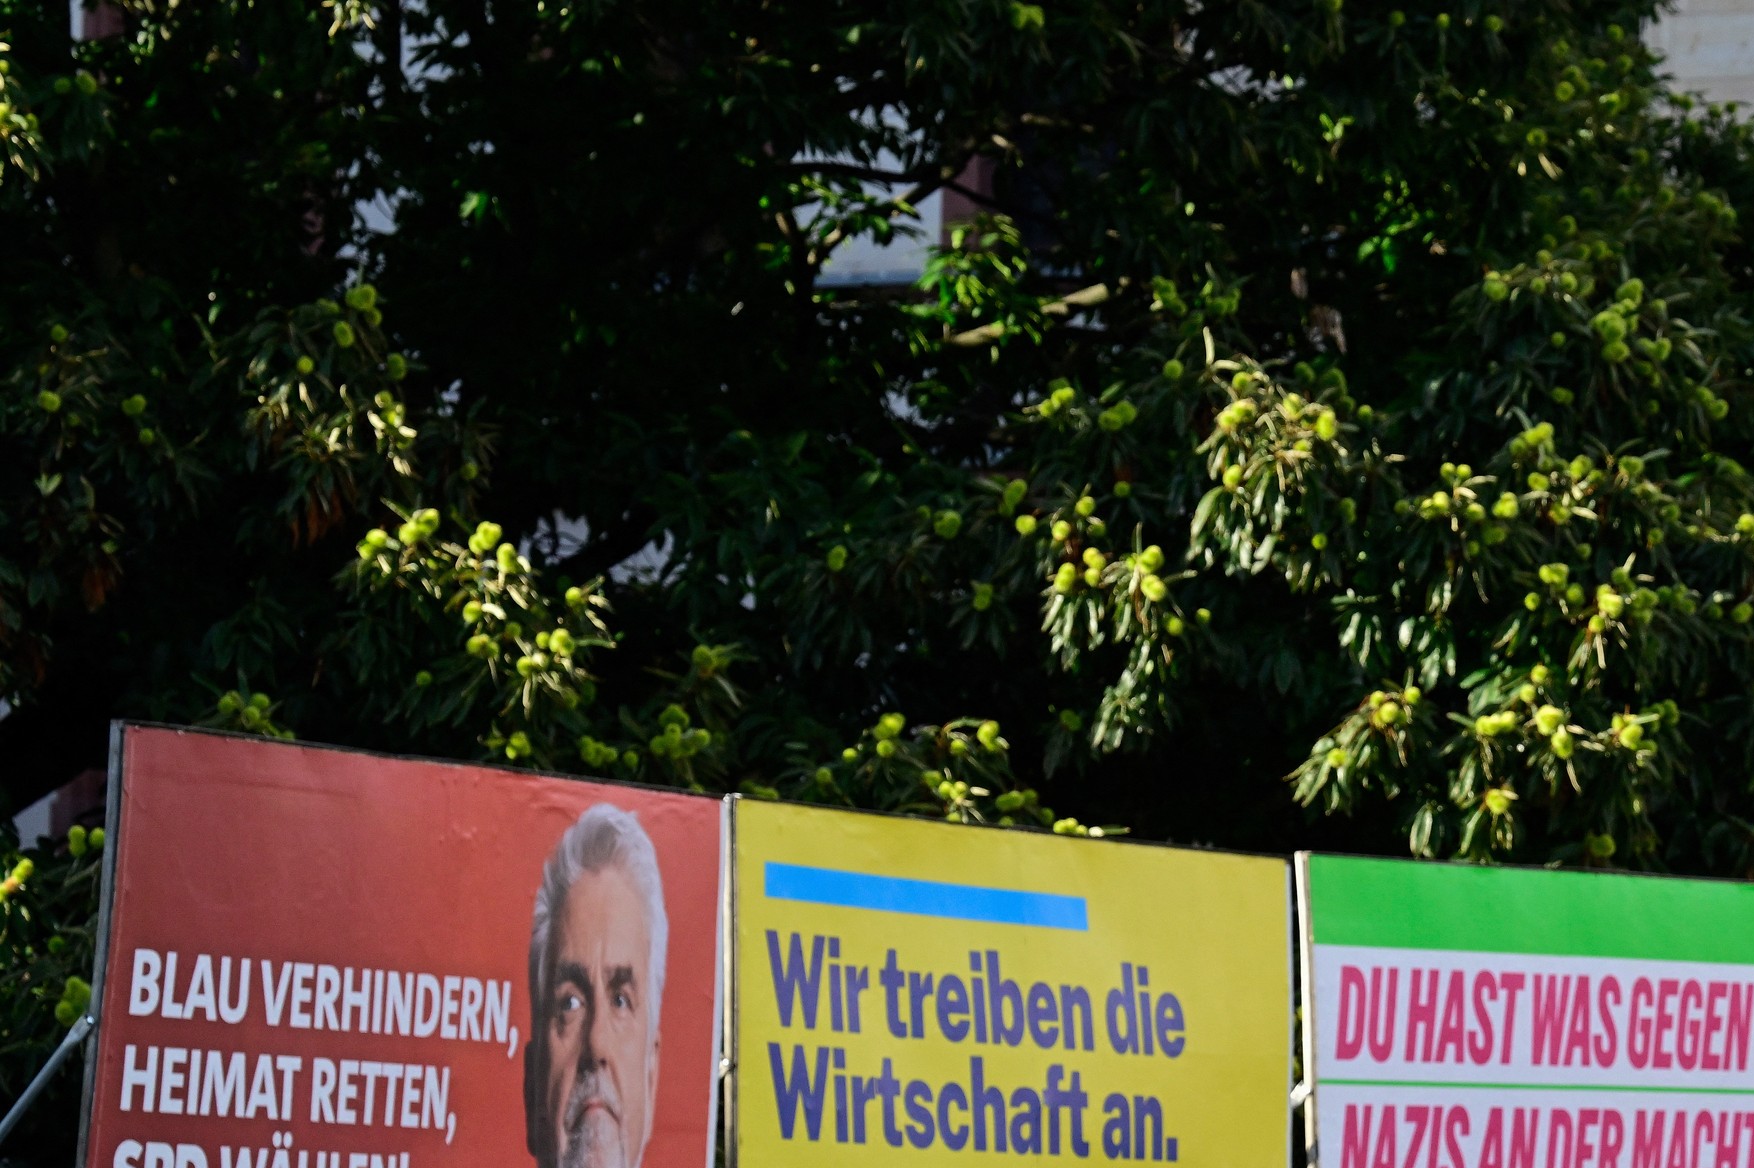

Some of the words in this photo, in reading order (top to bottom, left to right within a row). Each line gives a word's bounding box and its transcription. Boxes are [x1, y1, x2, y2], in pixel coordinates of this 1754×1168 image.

[128, 948, 250, 1022] BLAU
[261, 961, 518, 1057] VERHINDERN,
[765, 928, 869, 1030] Wir
[878, 947, 1094, 1052] treiben
[1106, 961, 1186, 1059] die
[1336, 965, 1399, 1063] DU
[1404, 968, 1525, 1066] HAST
[1531, 973, 1621, 1069] WAS
[120, 1044, 301, 1120] HEIMAT
[311, 1058, 457, 1145] RETTEN,
[767, 1041, 1091, 1158] Wirtschaft
[1102, 1090, 1178, 1163] an.
